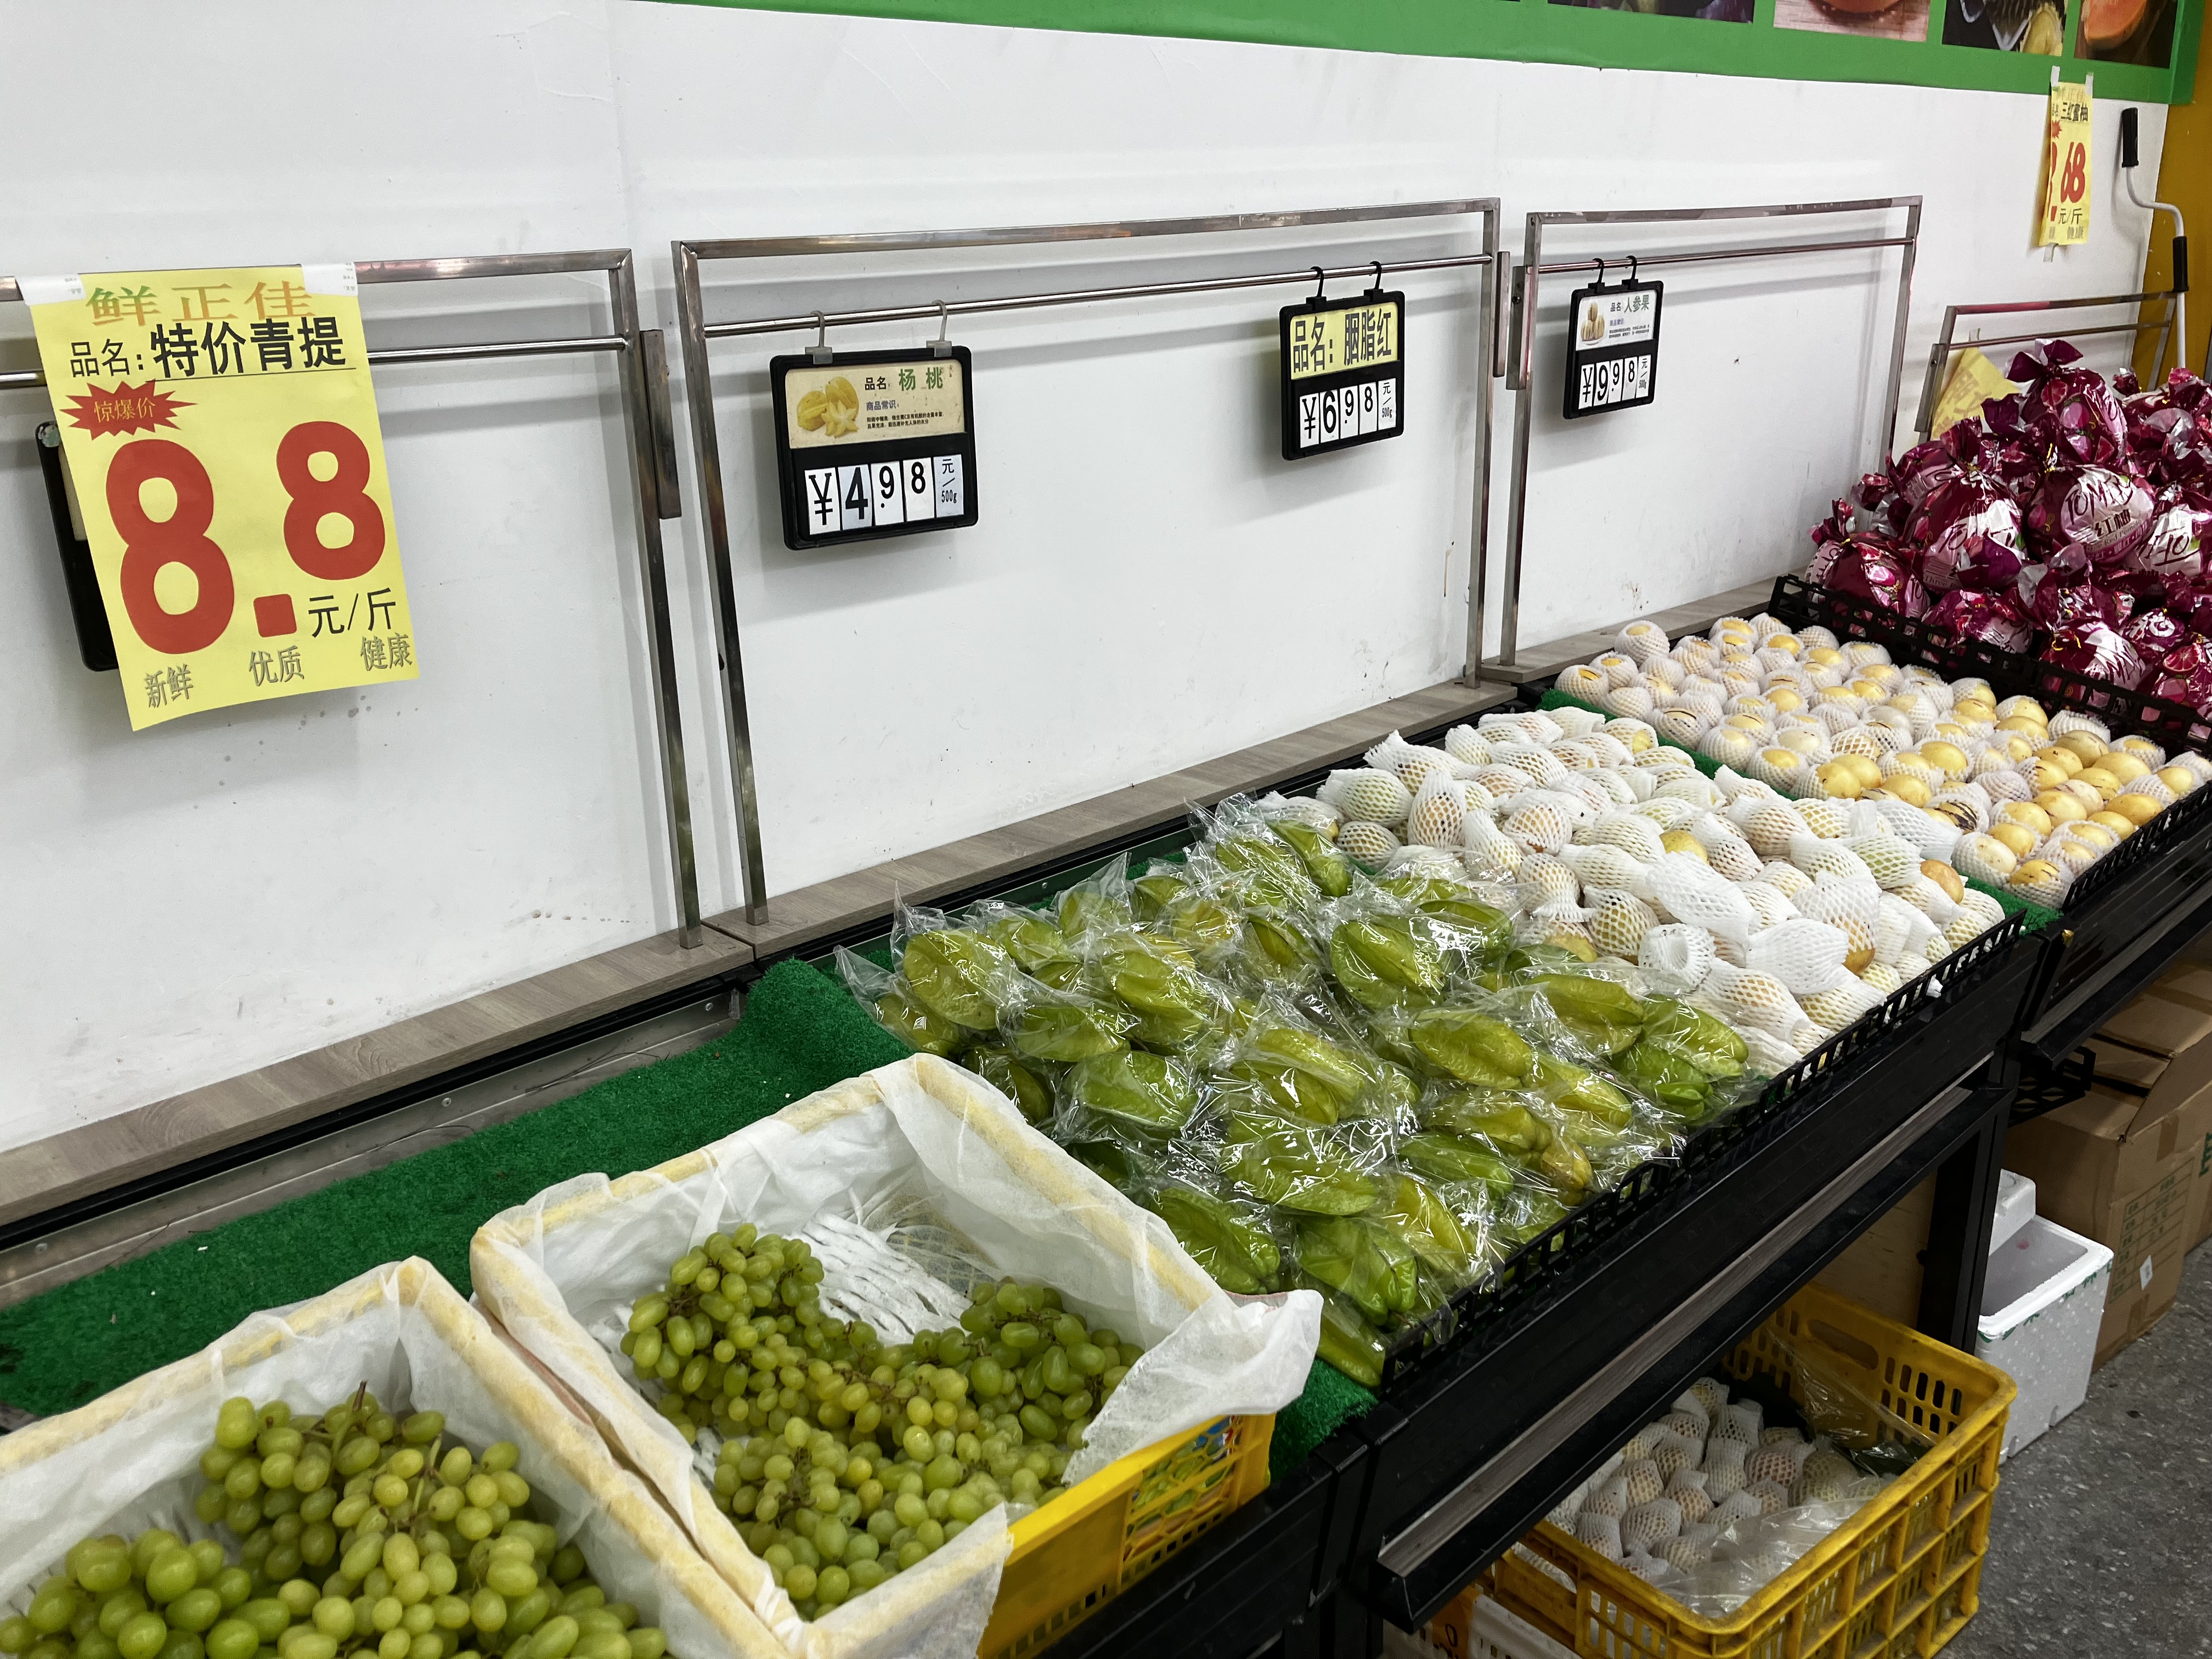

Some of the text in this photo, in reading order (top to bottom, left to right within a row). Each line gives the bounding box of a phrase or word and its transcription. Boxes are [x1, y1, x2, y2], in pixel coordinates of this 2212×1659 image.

[84, 280, 317, 326] 鲜正佳
[1624, 294, 1649, 313] 人参果
[94, 396, 156, 424] 惊爆价
[106, 421, 386, 654] 8.8
[308, 588, 397, 639] 元/斤
[144, 632, 413, 708] 新鲜 优质 健康
